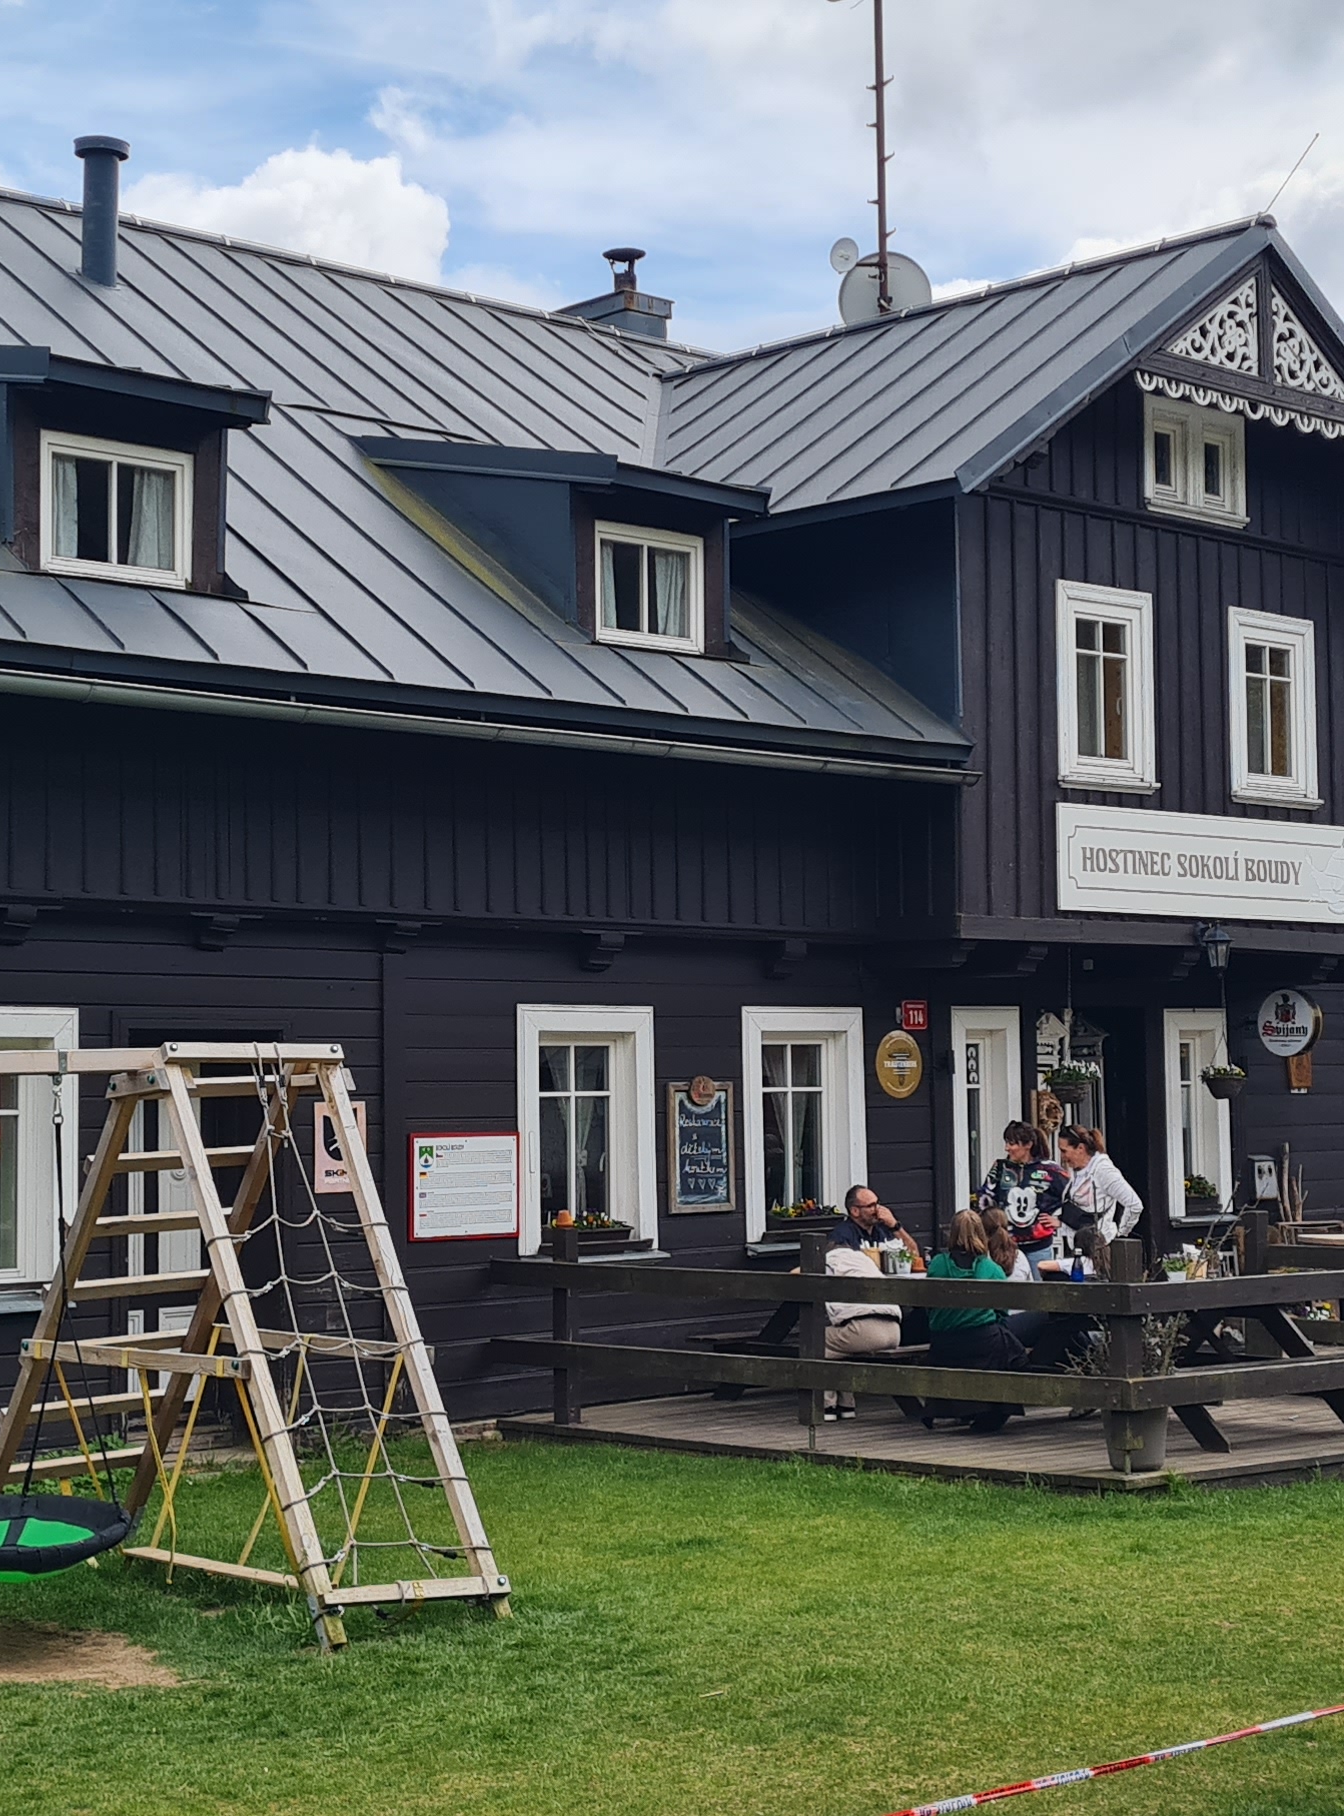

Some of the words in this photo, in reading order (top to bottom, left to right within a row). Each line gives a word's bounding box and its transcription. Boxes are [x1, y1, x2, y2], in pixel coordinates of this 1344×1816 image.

[1080, 846, 1172, 877] HOSTINEC
[1176, 850, 1239, 881] SOKOLÍ
[1245, 858, 1303, 886] BOUDY
[909, 1009, 924, 1025] 114
